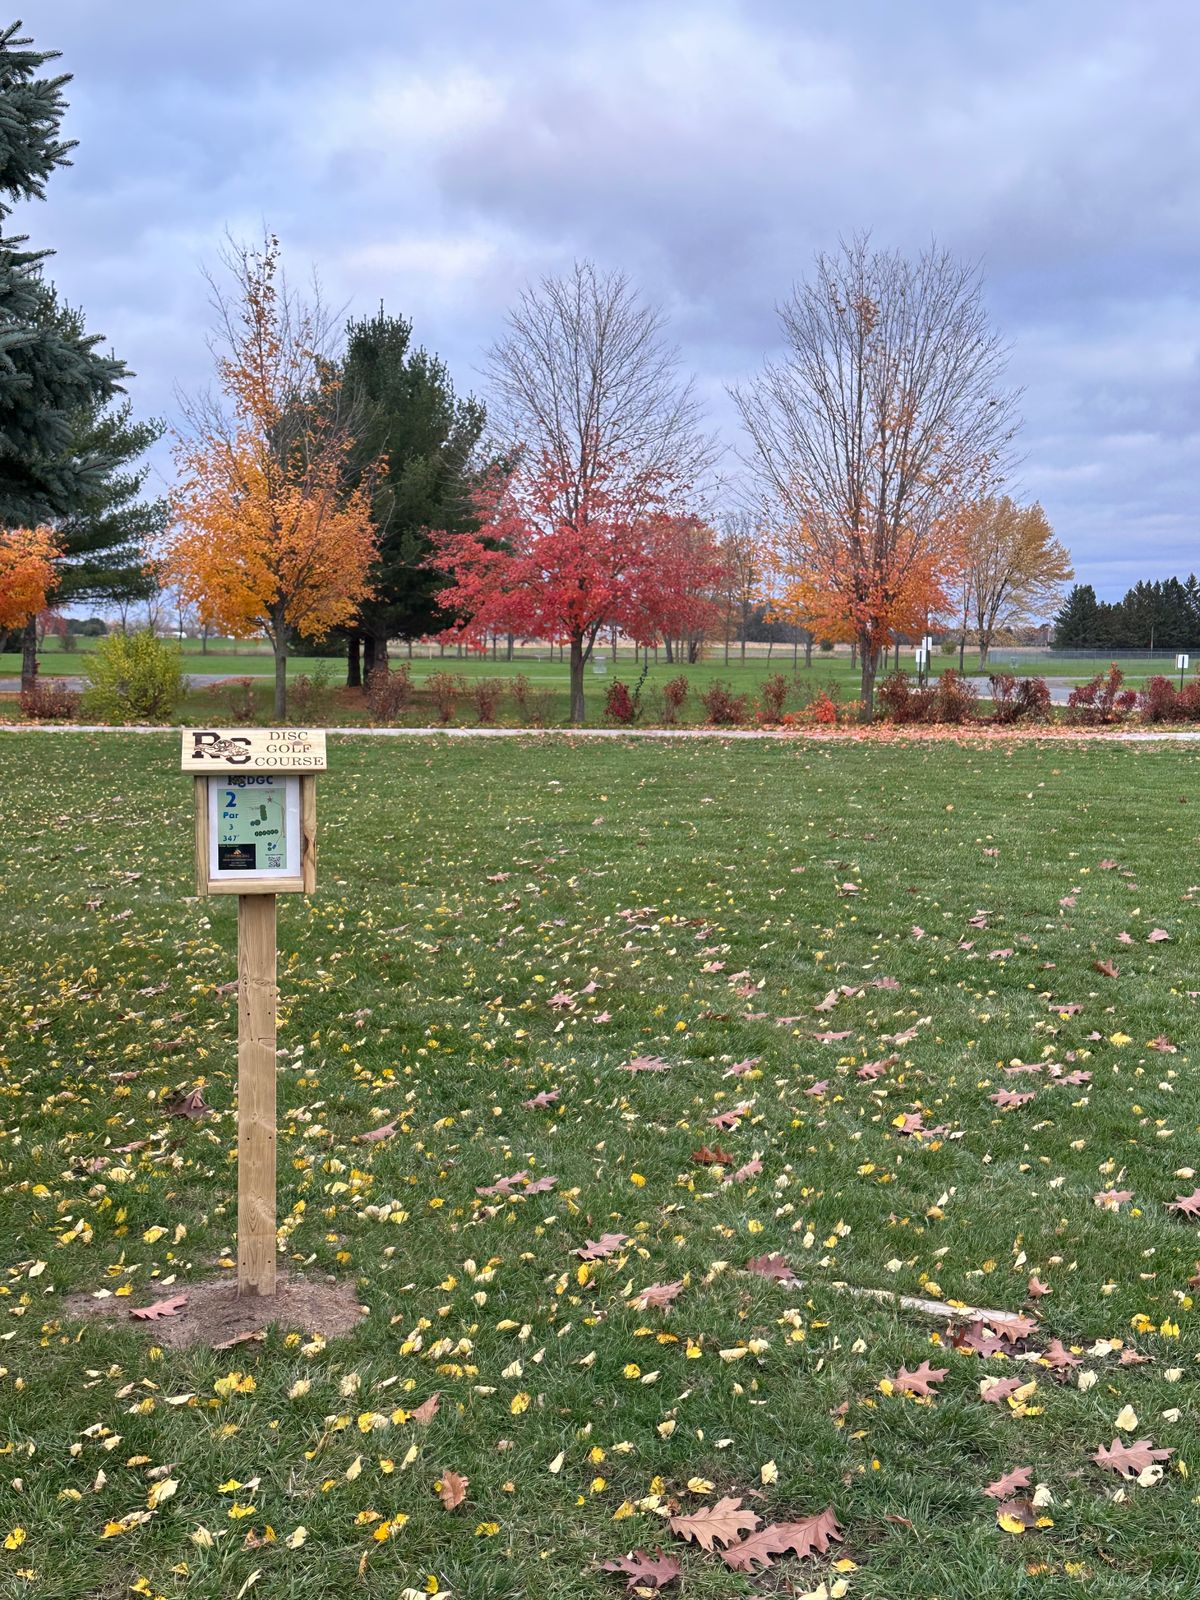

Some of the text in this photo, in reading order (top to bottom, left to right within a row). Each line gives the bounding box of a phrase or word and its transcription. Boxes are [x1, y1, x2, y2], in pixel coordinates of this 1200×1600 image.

[270, 731, 308, 741] DISC
[266, 744, 312, 753] GOLF
[254, 756, 324, 767] COURSE
[225, 791, 237, 808] 2
[223, 811, 239, 819] Par
[228, 823, 234, 831] 3
